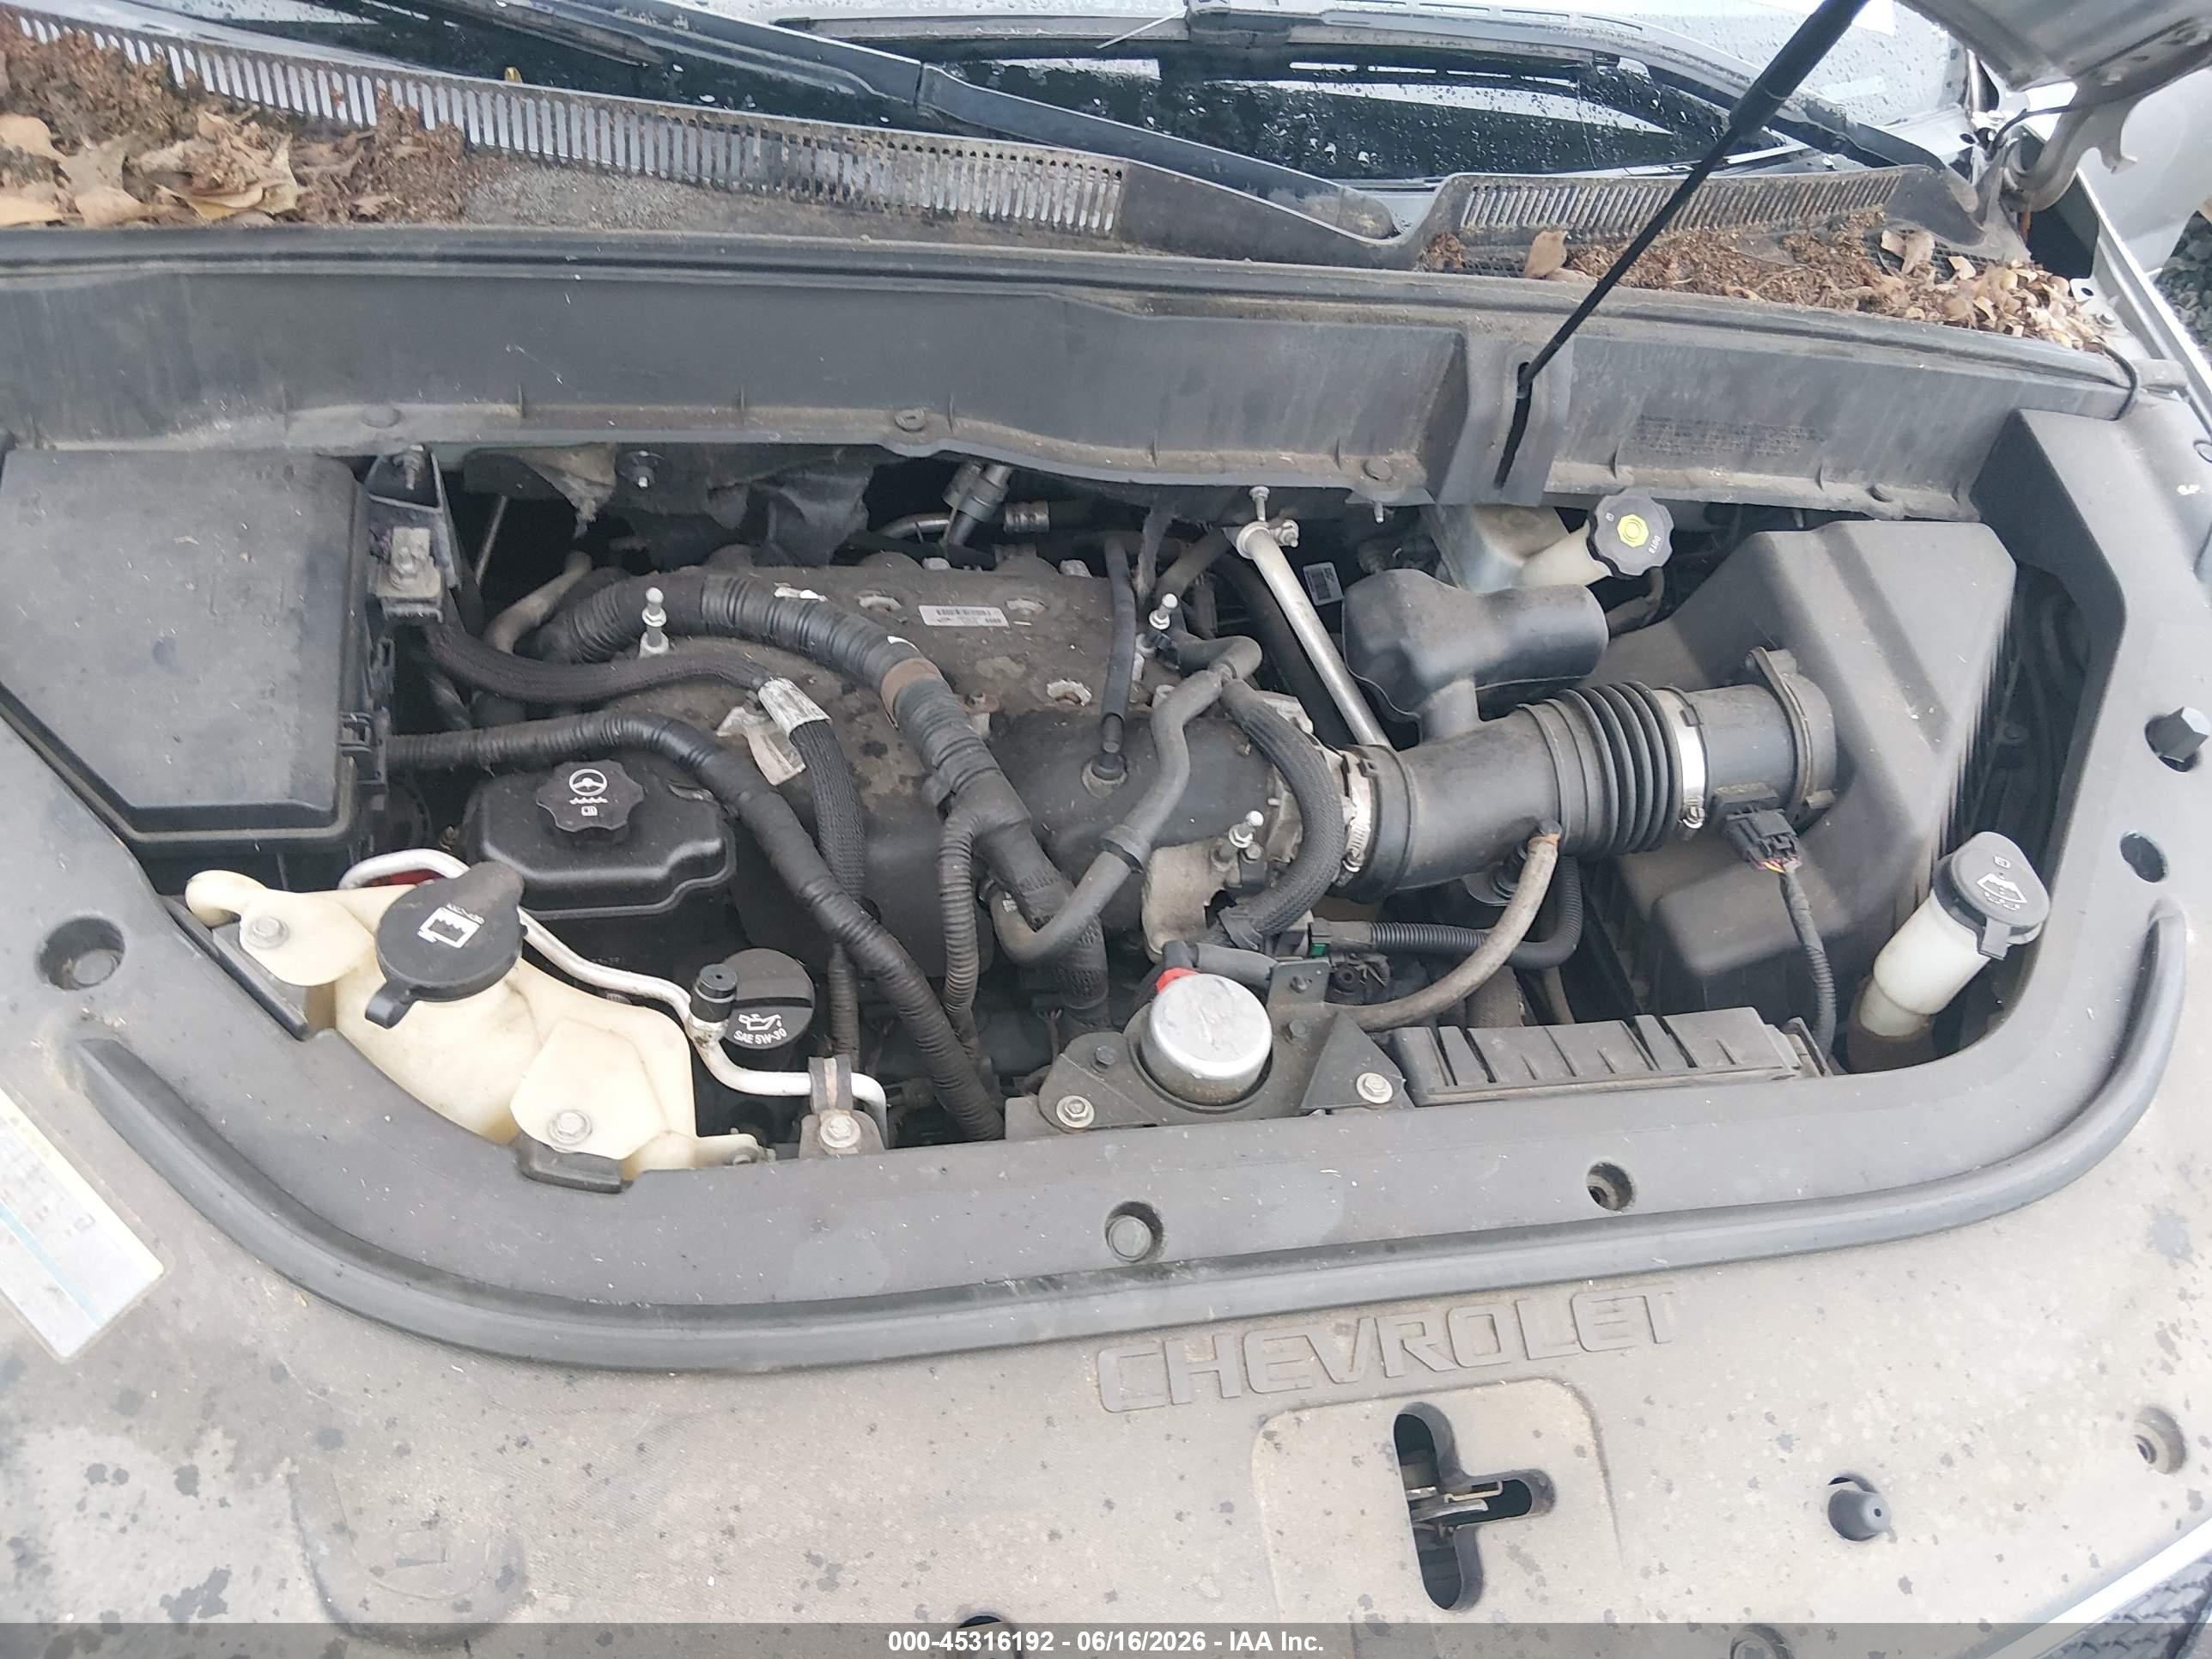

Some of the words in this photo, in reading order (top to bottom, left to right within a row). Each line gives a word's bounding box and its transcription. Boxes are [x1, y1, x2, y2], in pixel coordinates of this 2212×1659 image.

[733, 1030, 754, 1045] SAE
[755, 1027, 787, 1045] 5W-30
[1097, 1291, 1675, 1413] CHEVROLET
